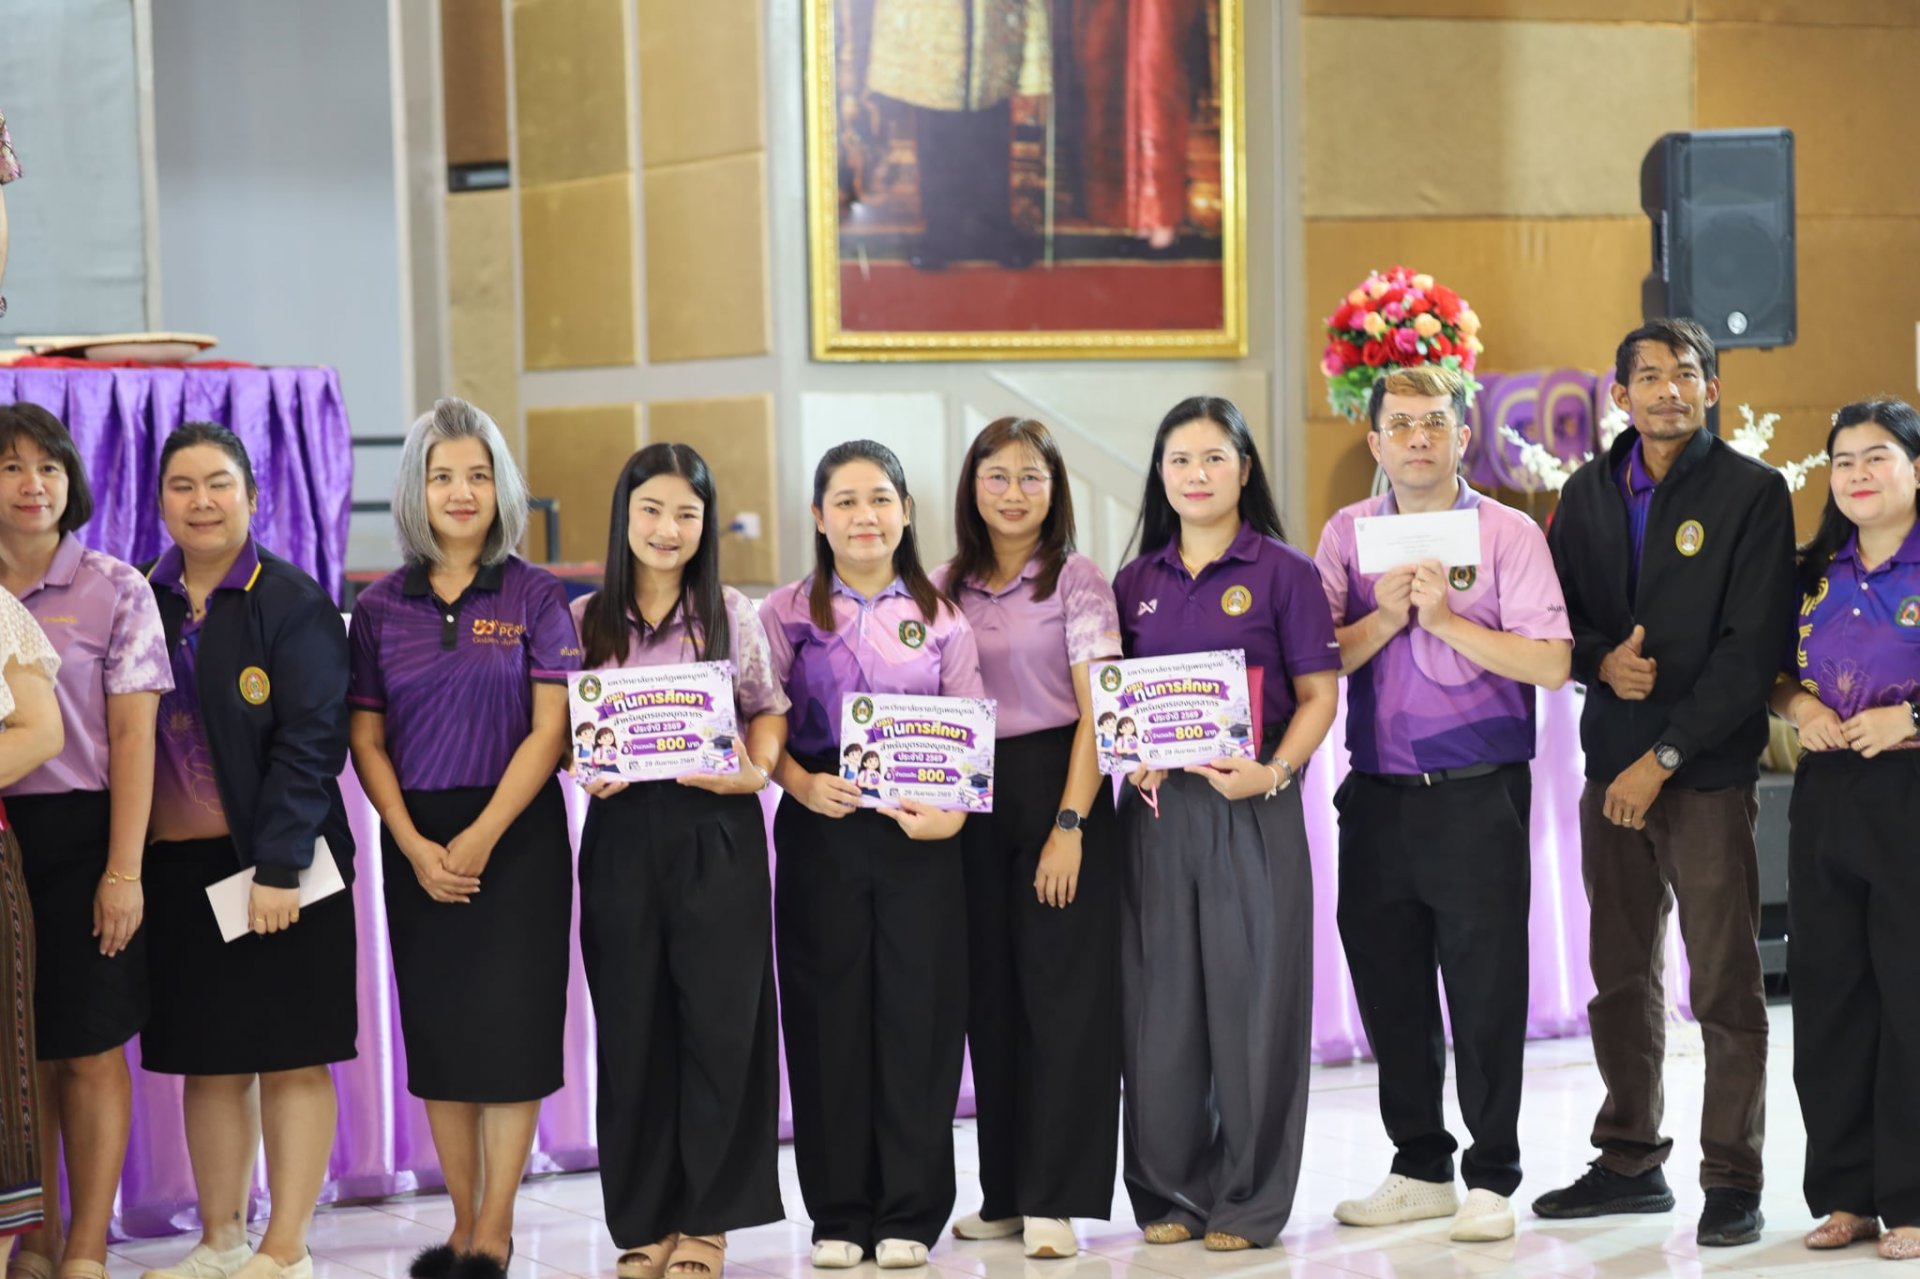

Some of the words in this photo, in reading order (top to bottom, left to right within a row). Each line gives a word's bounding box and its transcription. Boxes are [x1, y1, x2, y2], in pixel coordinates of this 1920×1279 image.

[1125, 681, 1144, 693] มอบ
[1133, 679, 1220, 702] ทุนการศึกษา
[605, 692, 625, 704] มอบ
[613, 689, 704, 713] ทุนการศึกษา
[1134, 700, 1219, 715] สำหรับบุตรของบุคลากร
[614, 711, 703, 726] สำหรับบุตรของบุคลากร
[875, 718, 894, 728] มอบ
[1153, 710, 1179, 722] ประจำปี
[633, 722, 661, 733] ประจำปี
[883, 721, 968, 741] ทุนการศึกษา
[1175, 725, 1203, 740] 800
[1204, 729, 1217, 737] บาท
[656, 736, 686, 751] 800
[880, 741, 964, 753] สำหรับบุตรของบุคลากร
[898, 752, 924, 762] ประจำปี
[917, 768, 945, 783] 800
